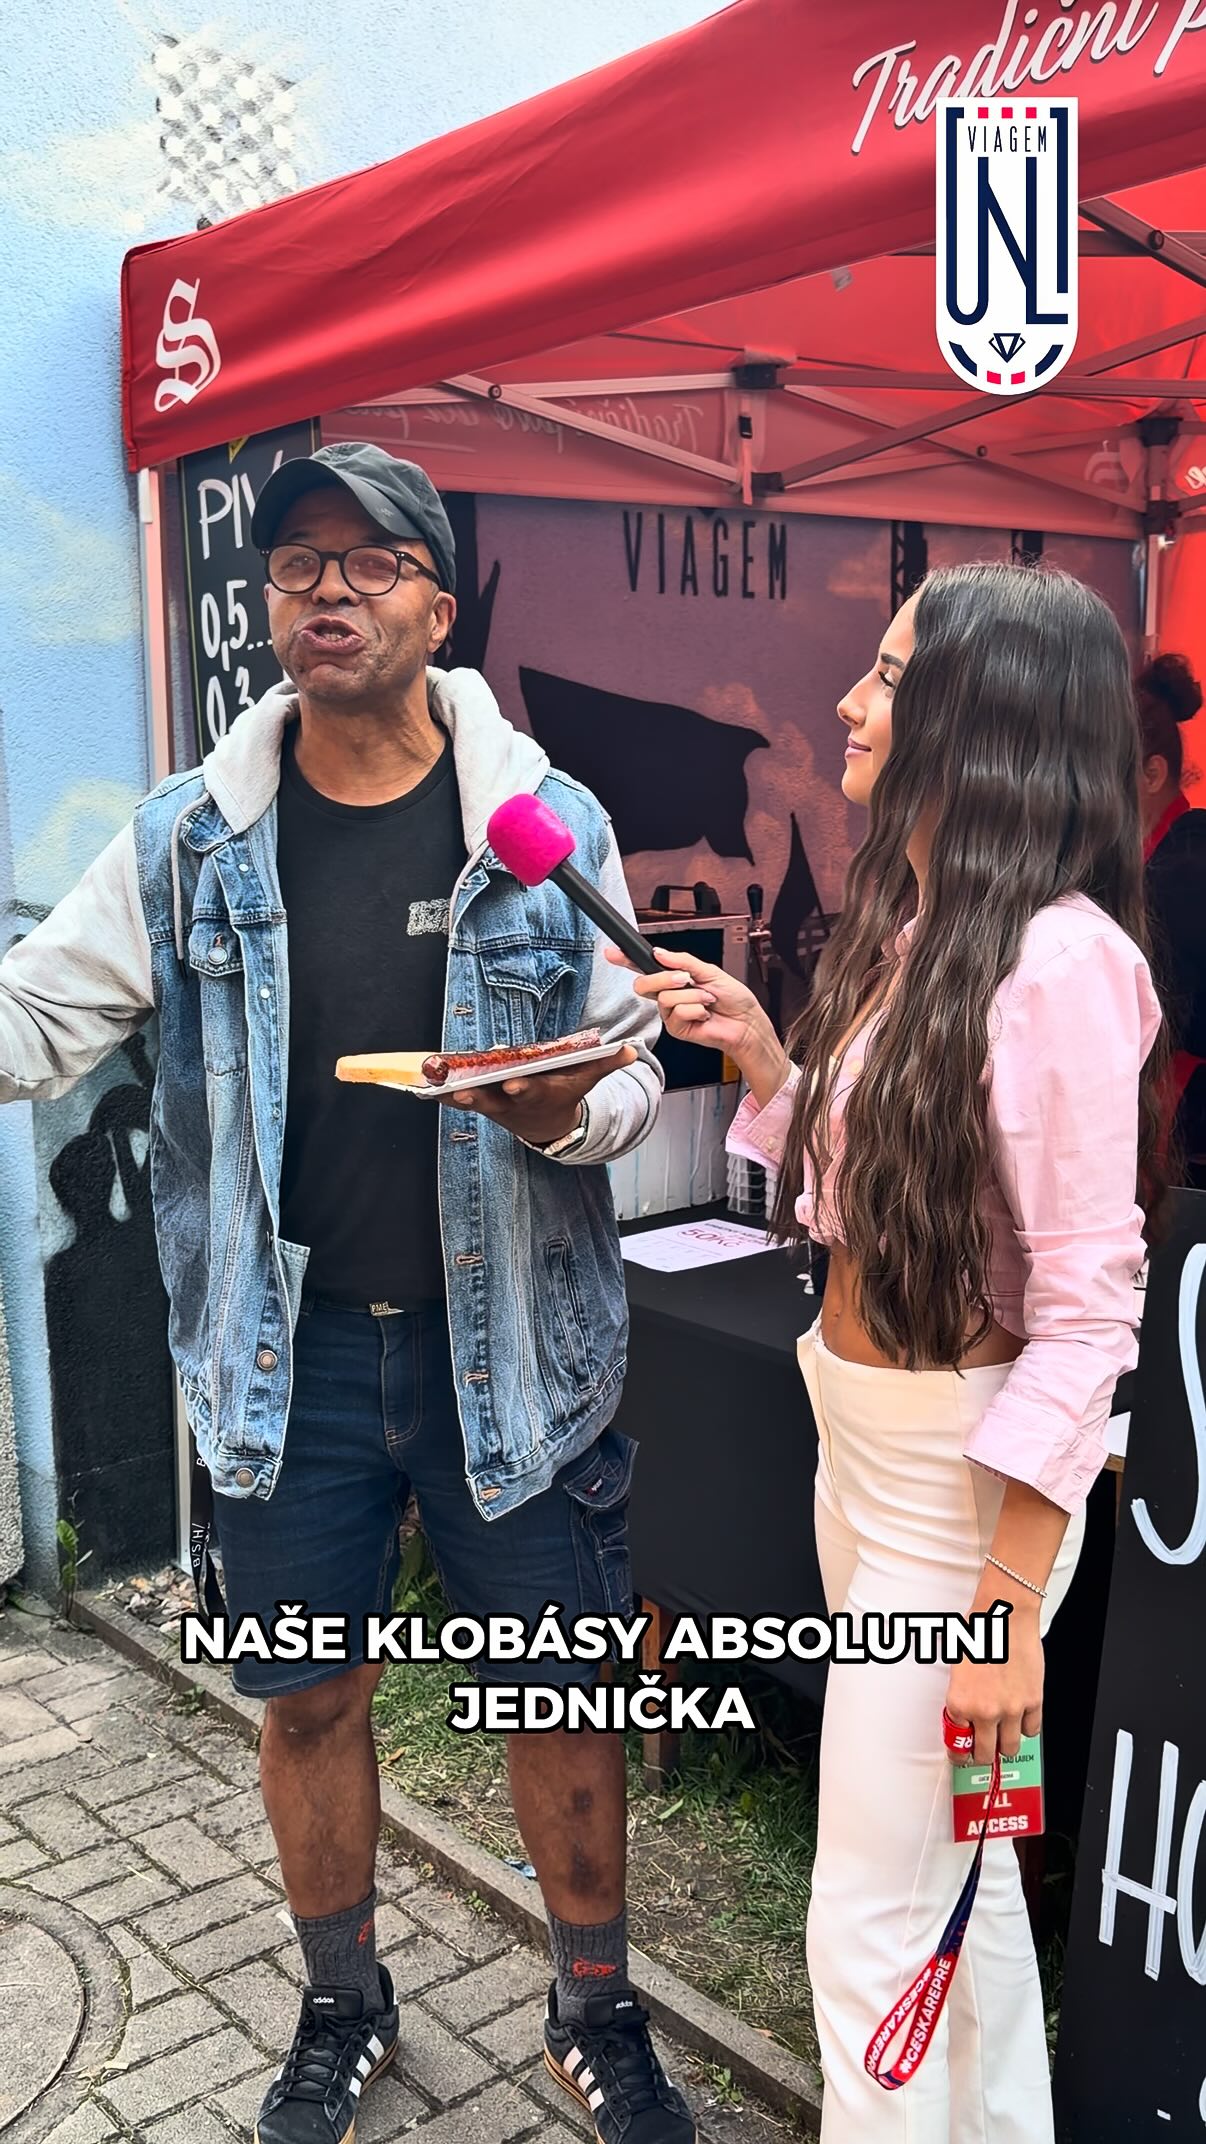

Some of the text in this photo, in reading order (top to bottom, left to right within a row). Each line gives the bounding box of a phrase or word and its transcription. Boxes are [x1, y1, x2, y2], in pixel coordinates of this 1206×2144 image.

[622, 509, 788, 600] VIAGEM
[866, 1967, 933, 2079] #CESKAREPR
[899, 1957, 952, 2075] #CESKAREPRE
